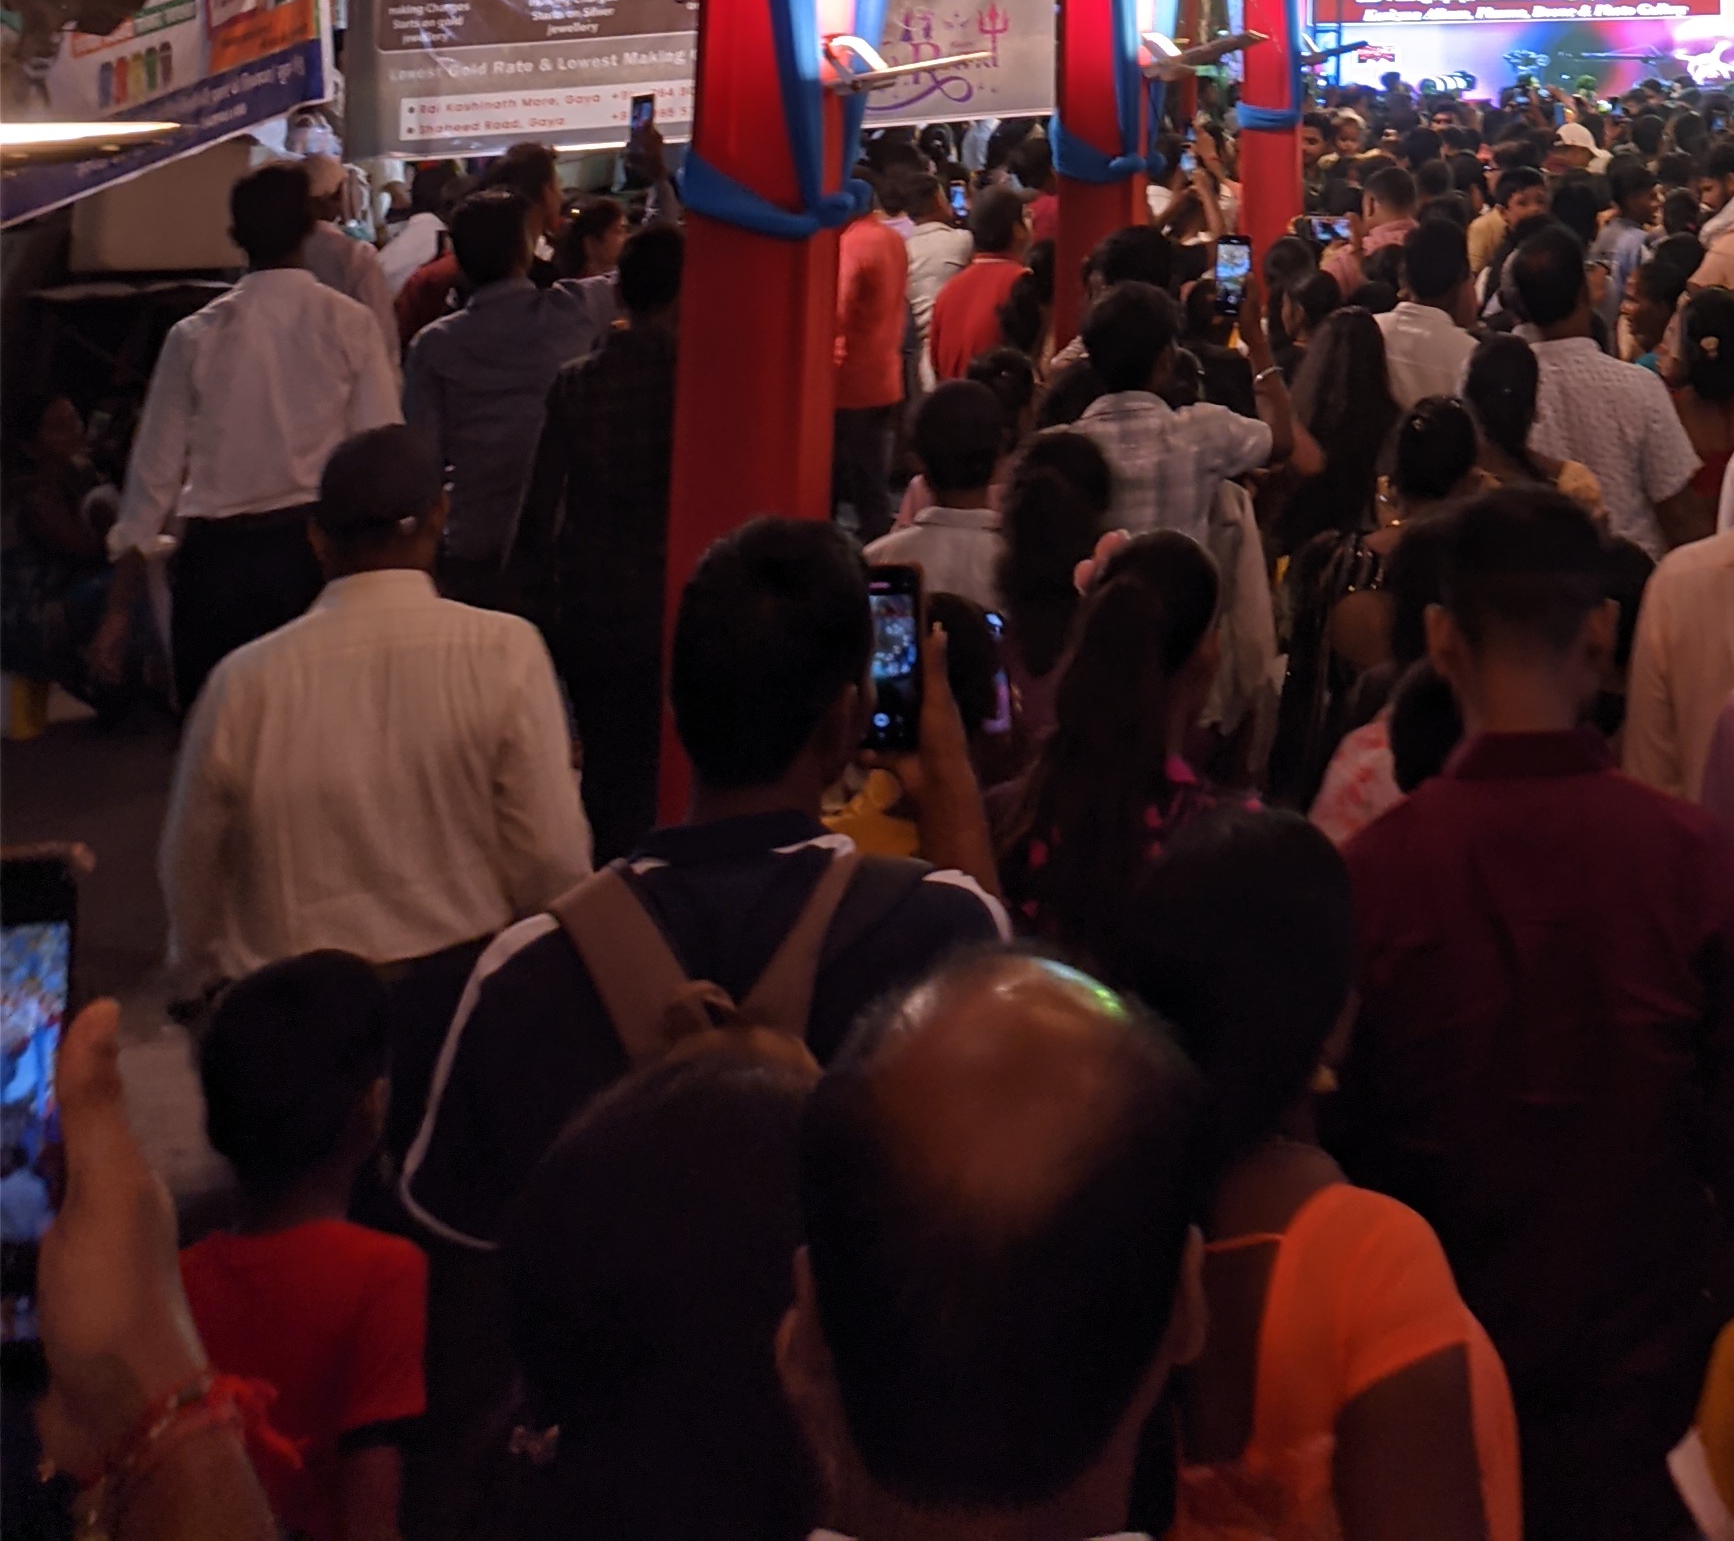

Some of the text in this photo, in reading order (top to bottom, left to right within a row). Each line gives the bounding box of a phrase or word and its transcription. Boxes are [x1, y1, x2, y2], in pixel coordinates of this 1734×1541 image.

[493, 60, 533, 74] Rate
[539, 57, 553, 72] &
[557, 53, 618, 71] Lowest
[623, 49, 686, 65] Making
